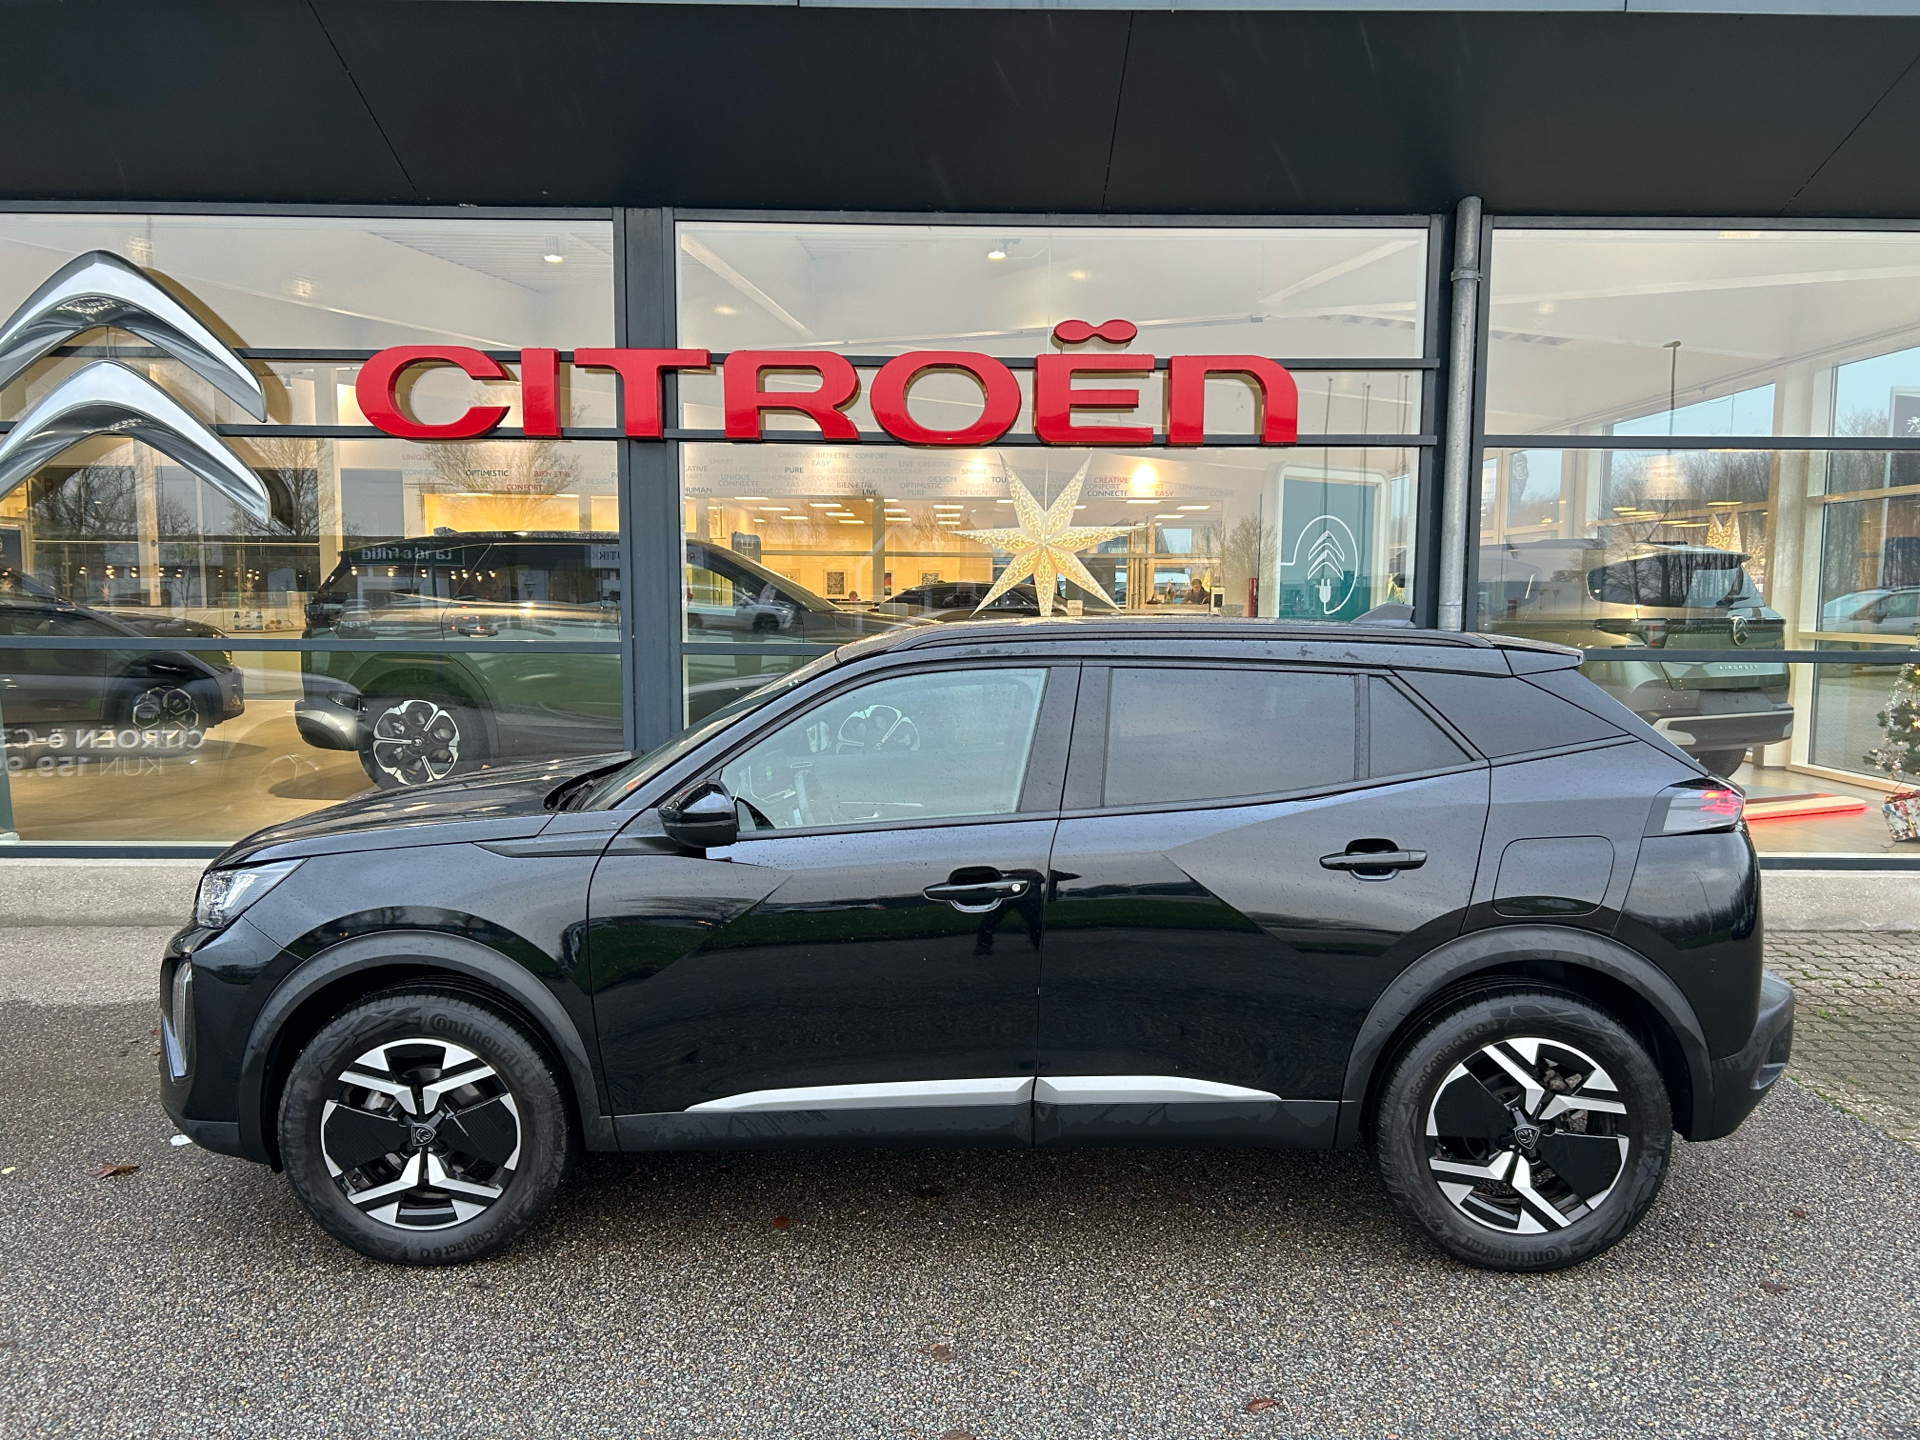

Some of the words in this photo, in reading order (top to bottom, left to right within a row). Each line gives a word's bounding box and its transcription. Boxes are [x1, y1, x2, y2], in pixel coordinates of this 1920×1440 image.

[355, 319, 1298, 447] CITROËN
[465, 469, 509, 477] OPTIMISTIC
[1093, 476, 1129, 484] CREATIVE
[429, 1013, 521, 1067] Continental
[1409, 1035, 1464, 1096] EcoContact
